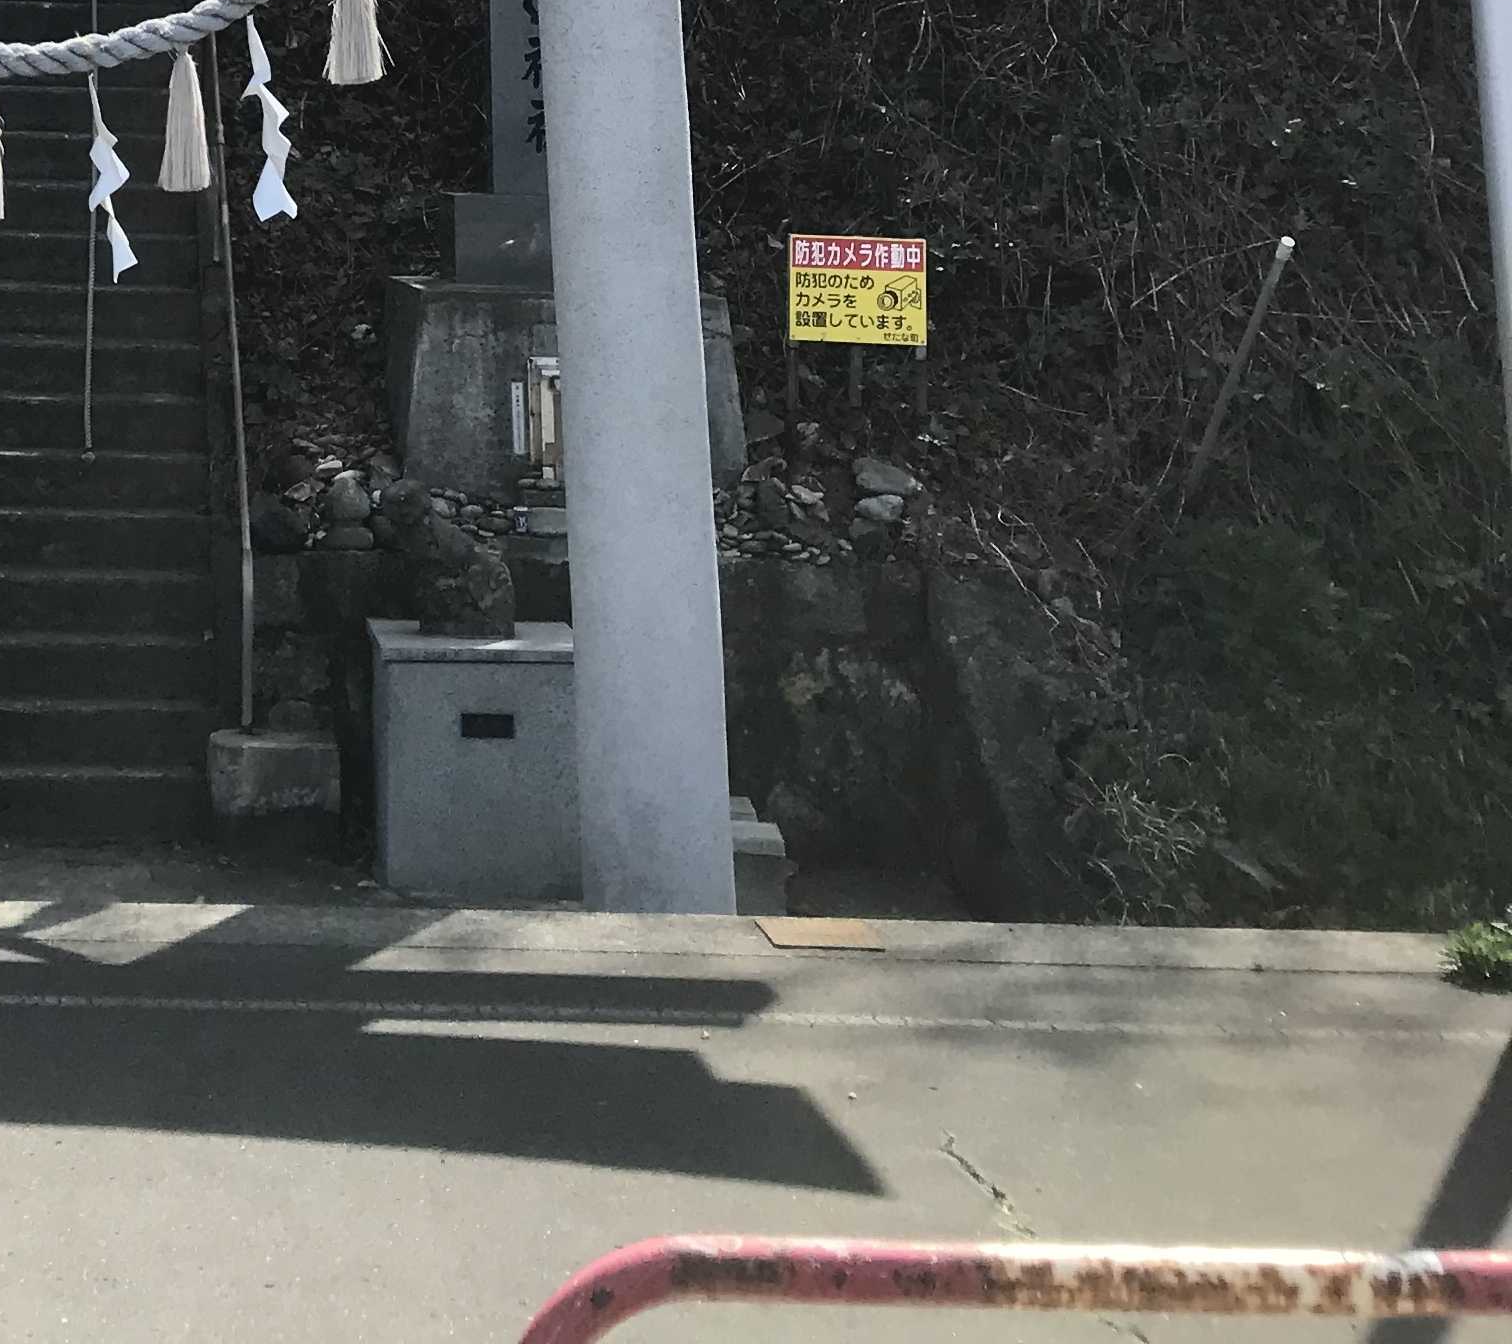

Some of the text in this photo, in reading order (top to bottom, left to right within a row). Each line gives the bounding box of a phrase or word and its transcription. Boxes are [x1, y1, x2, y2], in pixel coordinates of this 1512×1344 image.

[794, 240, 921, 269] 防犯カメラ作動中
[795, 272, 875, 290] 防犯のため
[795, 293, 857, 309] カメラを
[795, 310, 912, 331] 設置しています。
